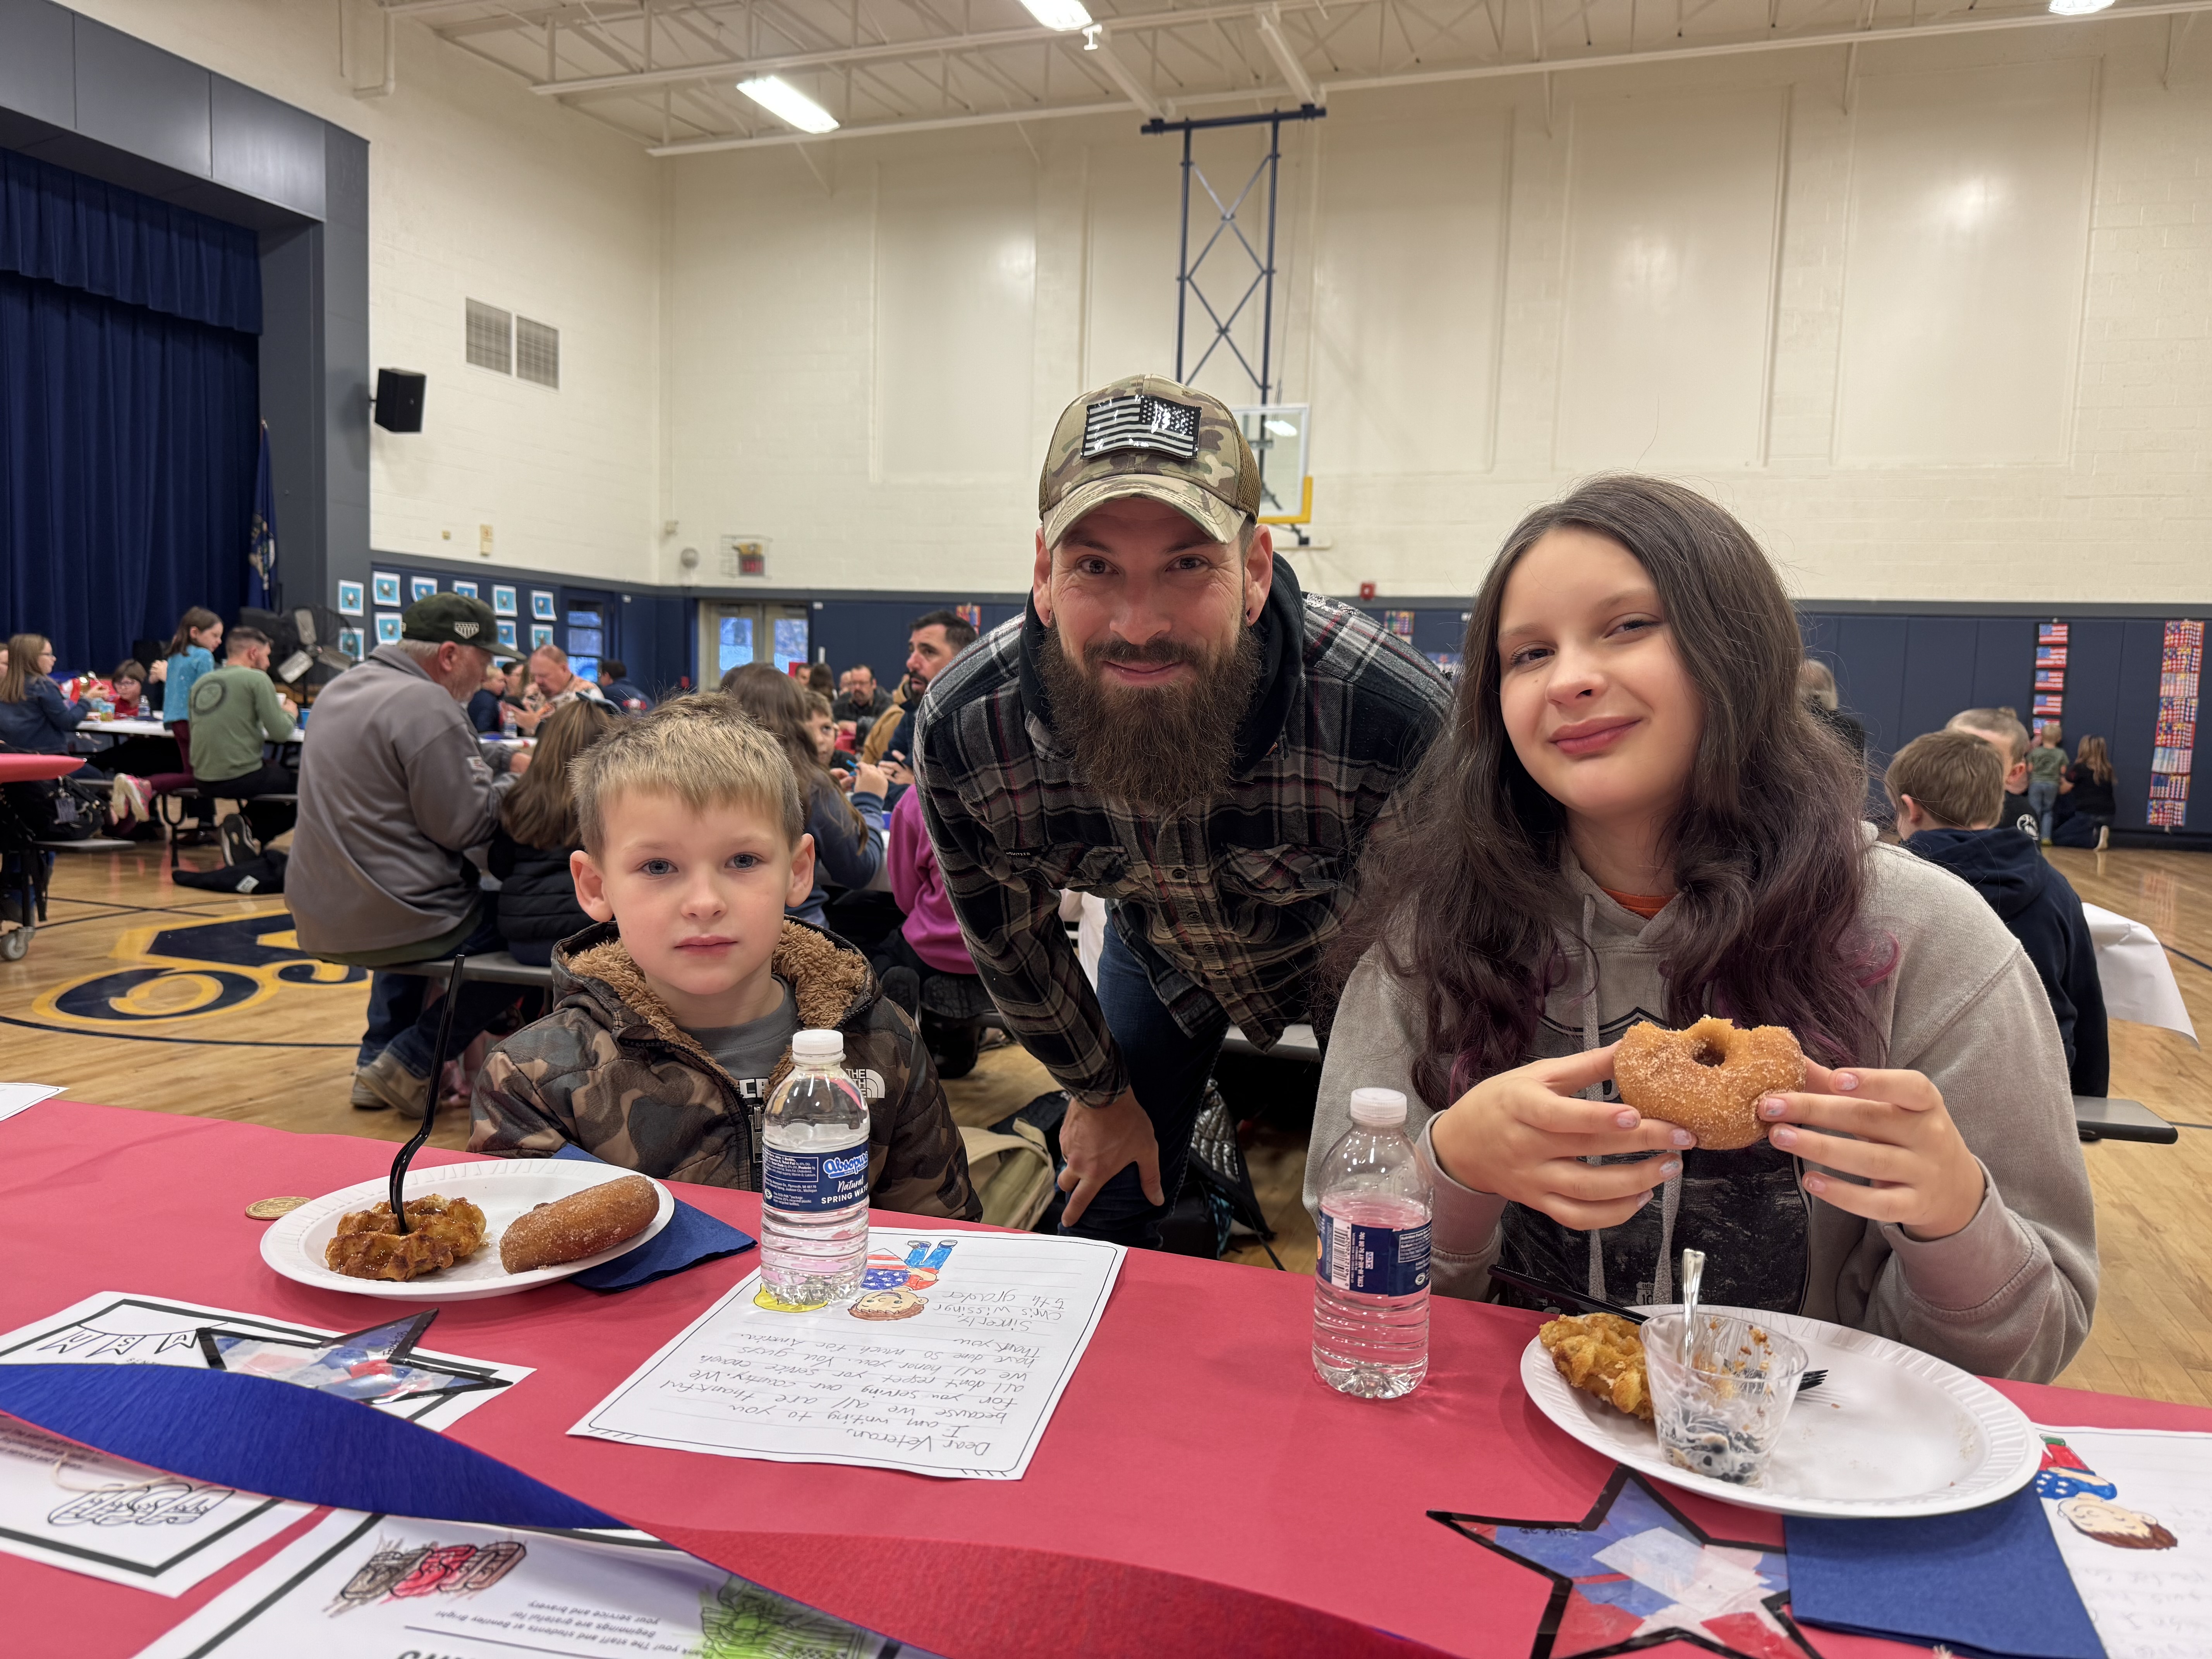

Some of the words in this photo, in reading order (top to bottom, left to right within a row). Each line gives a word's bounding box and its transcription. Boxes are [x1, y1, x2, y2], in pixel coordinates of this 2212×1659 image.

[846, 1068, 866, 1079] THE
[837, 1175, 865, 1192] Natural
[821, 1192, 852, 1204] SPRING
[942, 1289, 1018, 1304] grader
[738, 1346, 795, 1358] guys
[815, 1342, 847, 1352] for
[859, 1344, 906, 1355] much
[953, 1353, 983, 1364] done
[994, 1356, 1036, 1368] have
[765, 1364, 819, 1376] service
[898, 1364, 942, 1375] honor
[954, 1366, 986, 1376] all
[689, 1369, 721, 1382] We
[659, 1379, 755, 1401] thankful
[811, 1383, 842, 1391] our
[993, 1382, 1025, 1393] all
[861, 1386, 919, 1400] serving
[932, 1393, 963, 1401] you
[775, 1394, 818, 1405] are
[831, 1396, 870, 1409] all
[979, 1397, 1018, 1411] for
[730, 1404, 777, 1415] you
[788, 1411, 812, 1422] to
[828, 1411, 889, 1424] writing
[907, 1417, 939, 1426] am
[934, 1408, 1007, 1424] because
[942, 1425, 970, 1438] I
[846, 1428, 932, 1452] Veteran,
[943, 1440, 990, 1456] Dear
[569, 1607, 591, 1616] and
[634, 1616, 661, 1625] your
[528, 1625, 575, 1637] students
[577, 1632, 599, 1641] and
[599, 1636, 629, 1646] staff
[630, 1640, 651, 1650] The
